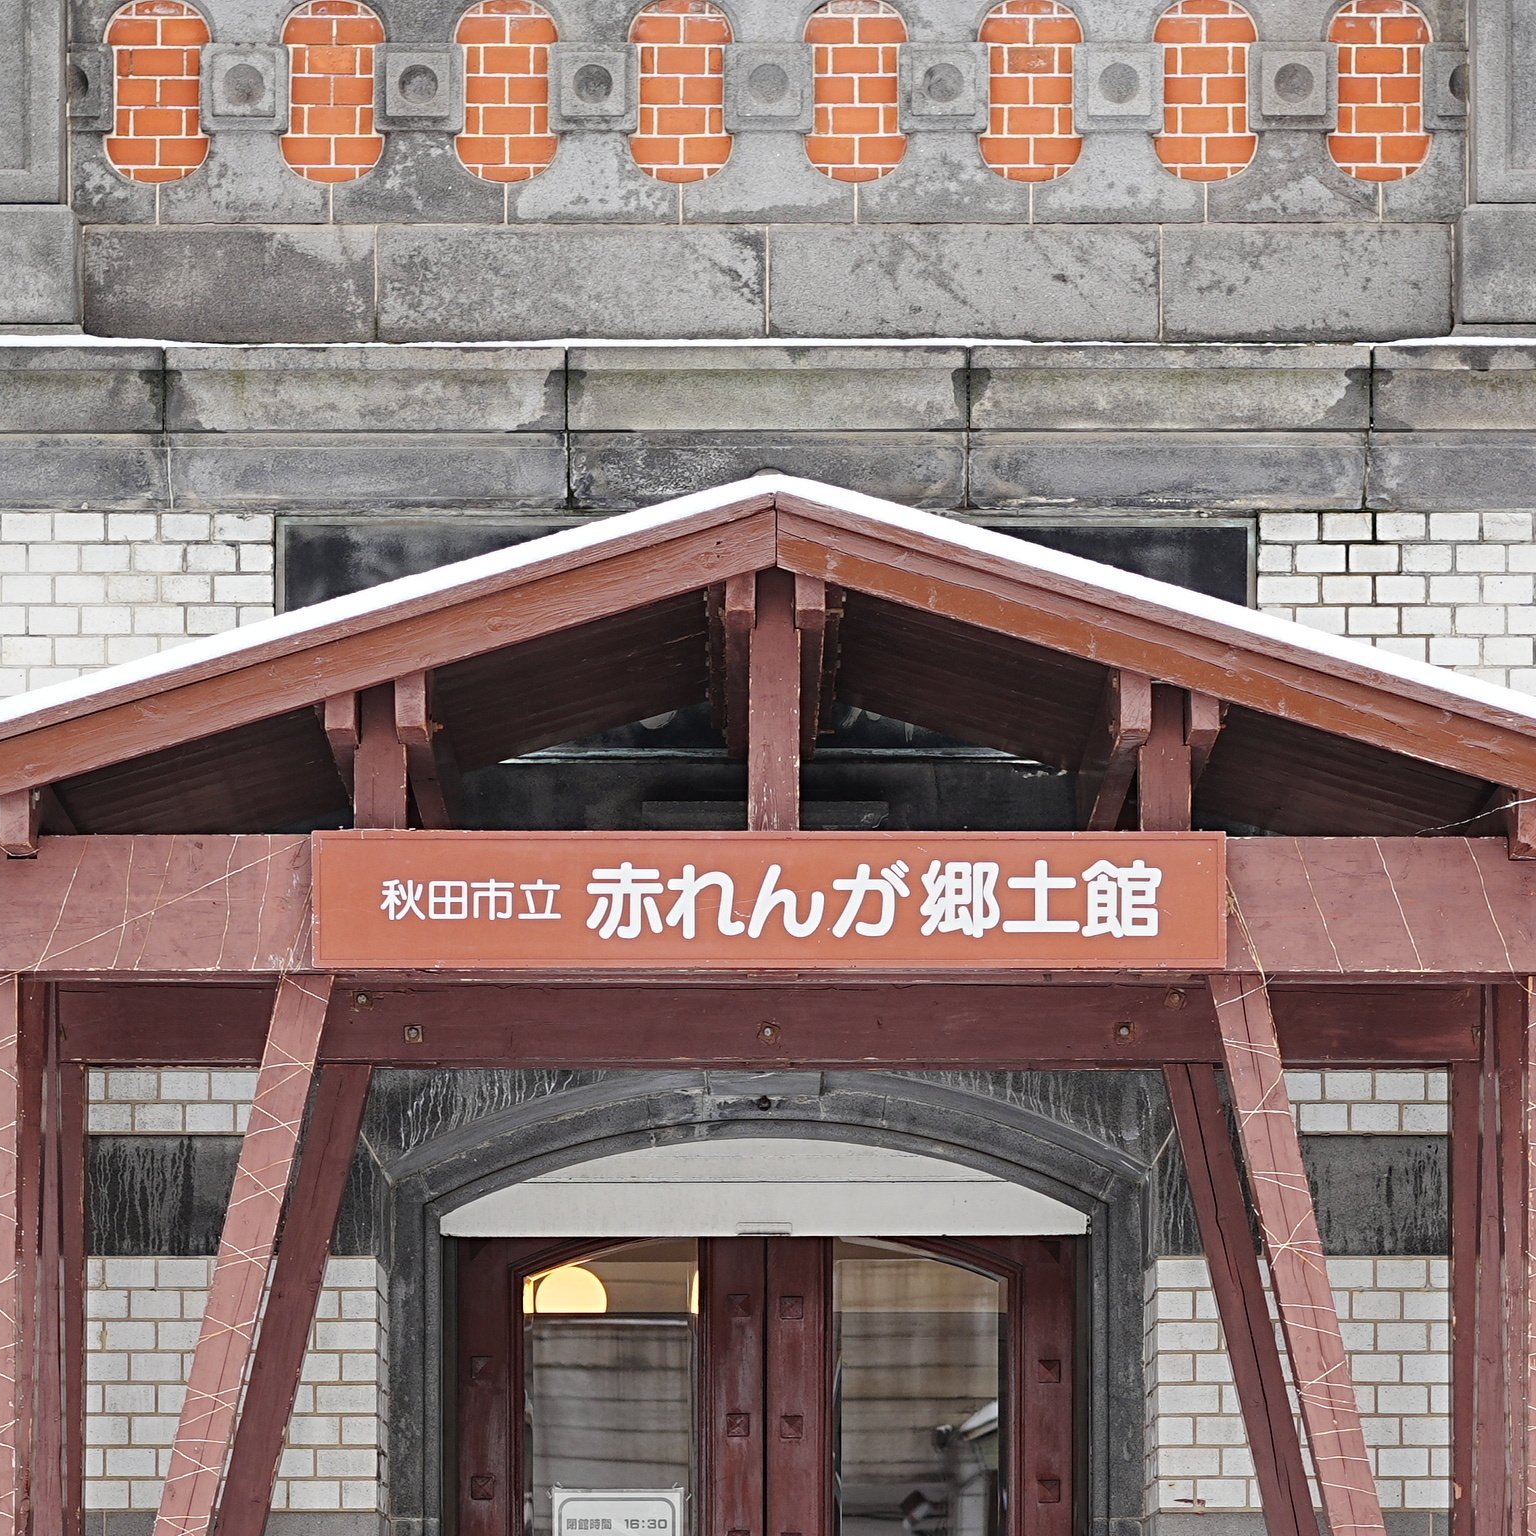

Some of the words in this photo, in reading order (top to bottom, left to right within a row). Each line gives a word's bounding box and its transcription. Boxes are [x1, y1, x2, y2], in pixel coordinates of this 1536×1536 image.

[380, 878, 561, 921] 秋田市立
[586, 858, 1162, 940] 赤れんが郷土館
[566, 1518, 612, 1530] 閉館時間
[624, 1518, 667, 1529] 16:30
